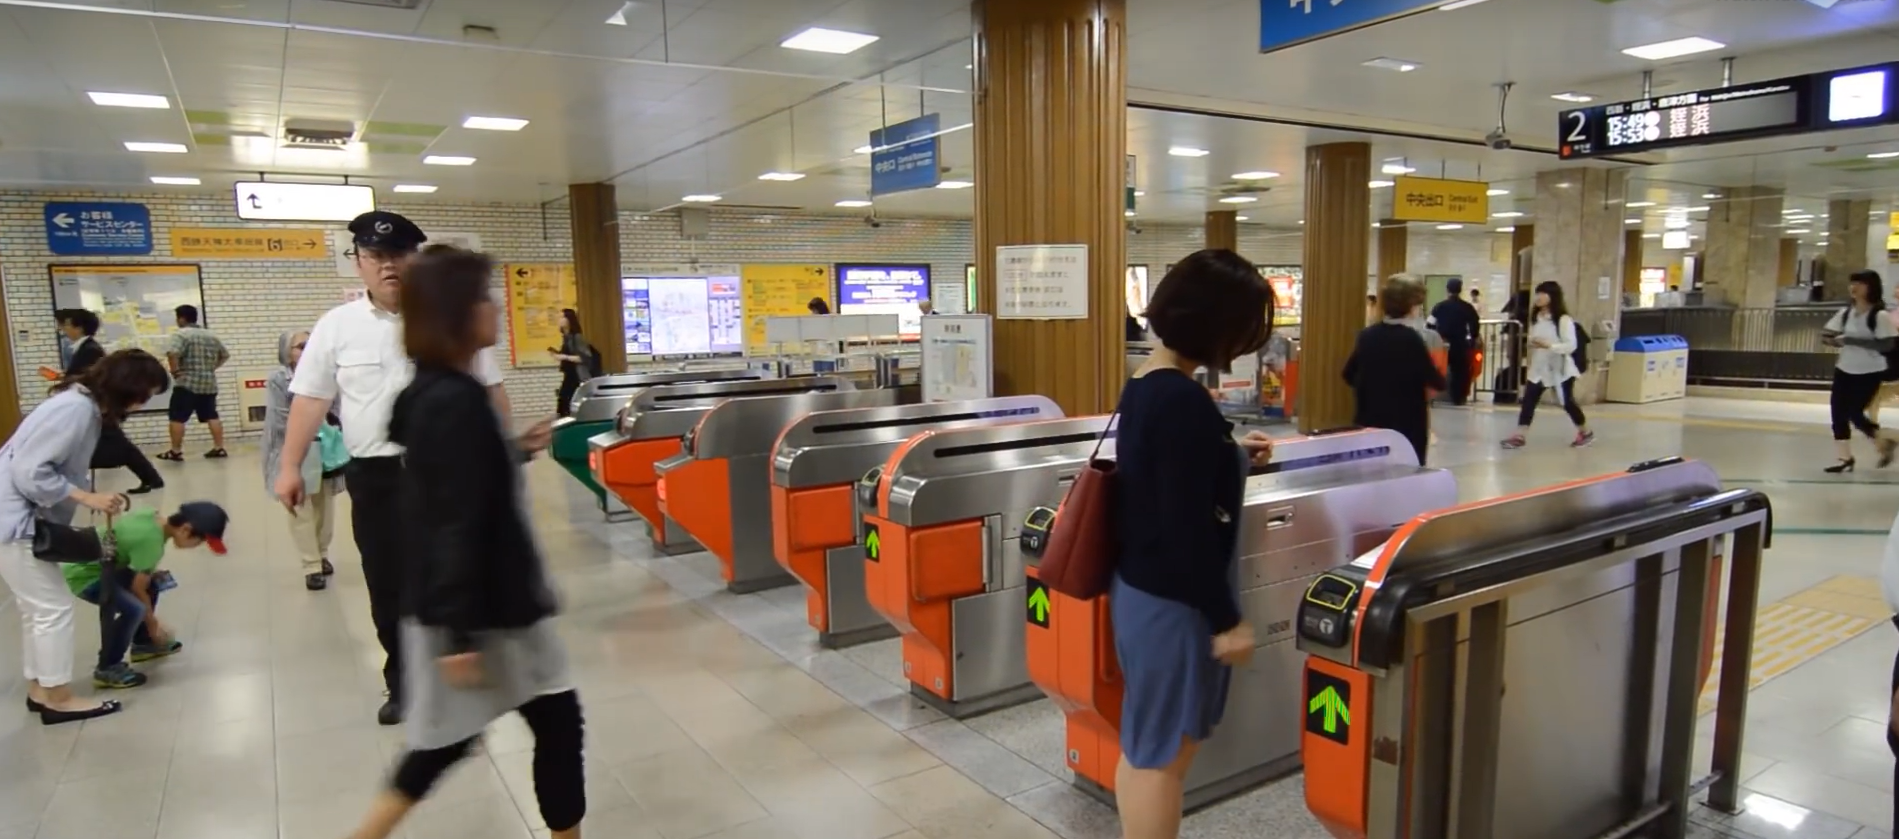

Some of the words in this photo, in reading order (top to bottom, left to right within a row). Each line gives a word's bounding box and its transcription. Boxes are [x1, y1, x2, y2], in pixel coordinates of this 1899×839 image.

[1567, 111, 1587, 142] 2
[1607, 112, 1644, 132] 15:49
[1607, 127, 1643, 146] 15:53
[80, 221, 144, 229] サービスセンター
